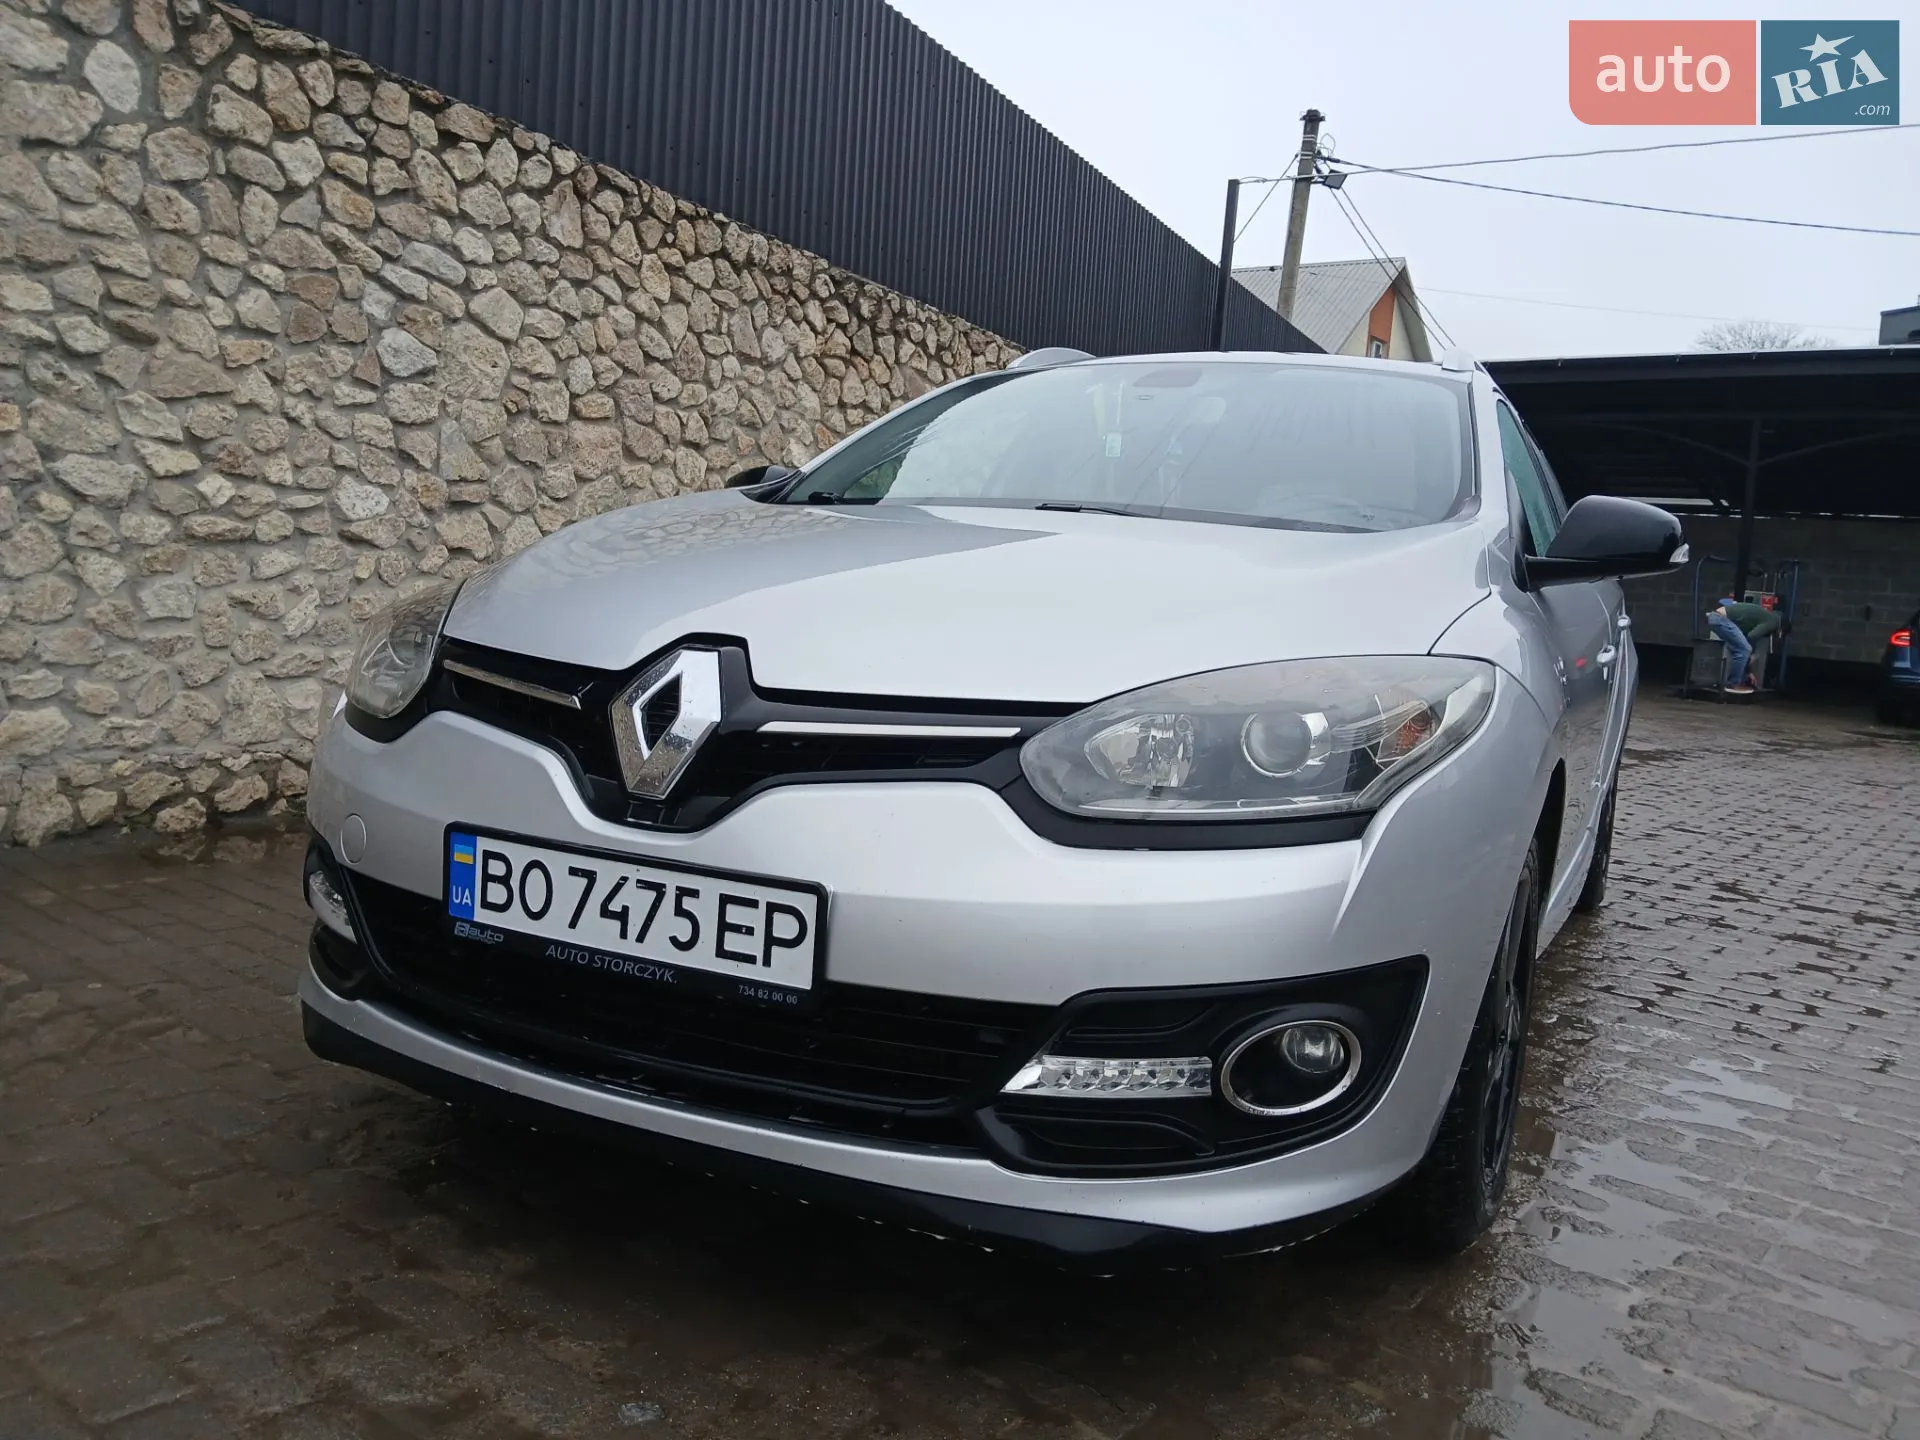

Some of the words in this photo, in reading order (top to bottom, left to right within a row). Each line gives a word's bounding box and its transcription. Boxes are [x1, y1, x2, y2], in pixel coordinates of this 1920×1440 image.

[452, 885, 472, 907] UA
[480, 849, 553, 921] BO
[568, 865, 701, 952] 7475
[715, 892, 808, 968] EP
[545, 944, 589, 965] AUTO
[592, 954, 678, 984] STORCZYK.
[738, 985, 755, 997] 734
[757, 990, 769, 999] 82
[772, 993, 784, 1002] 00
[786, 995, 798, 1005] 00
